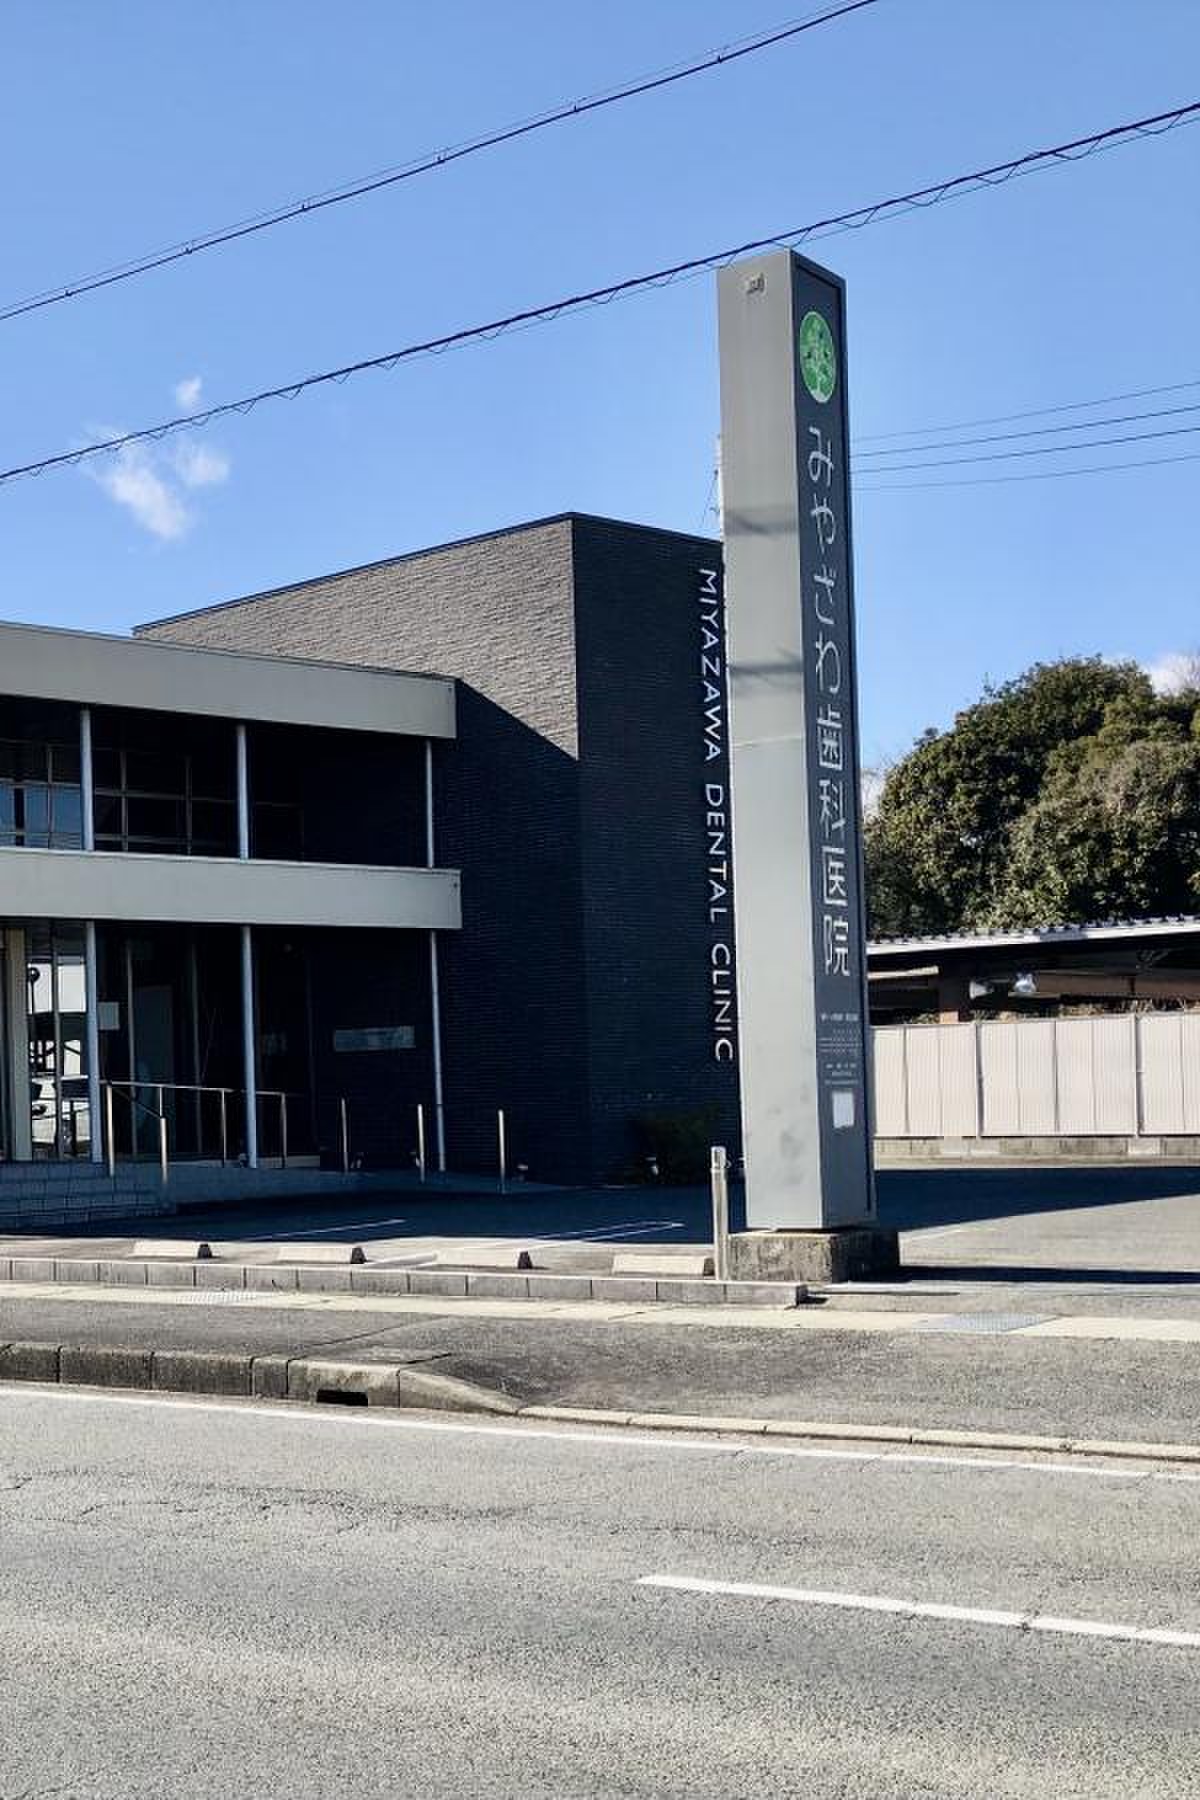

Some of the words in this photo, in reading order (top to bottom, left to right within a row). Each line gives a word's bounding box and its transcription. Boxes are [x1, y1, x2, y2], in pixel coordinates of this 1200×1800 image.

[699, 568, 722, 761] MIYAZAWA
[808, 426, 849, 976] みやざわ歯科医院
[705, 784, 728, 923] DENTAL
[711, 943, 734, 1062] CLINIC
